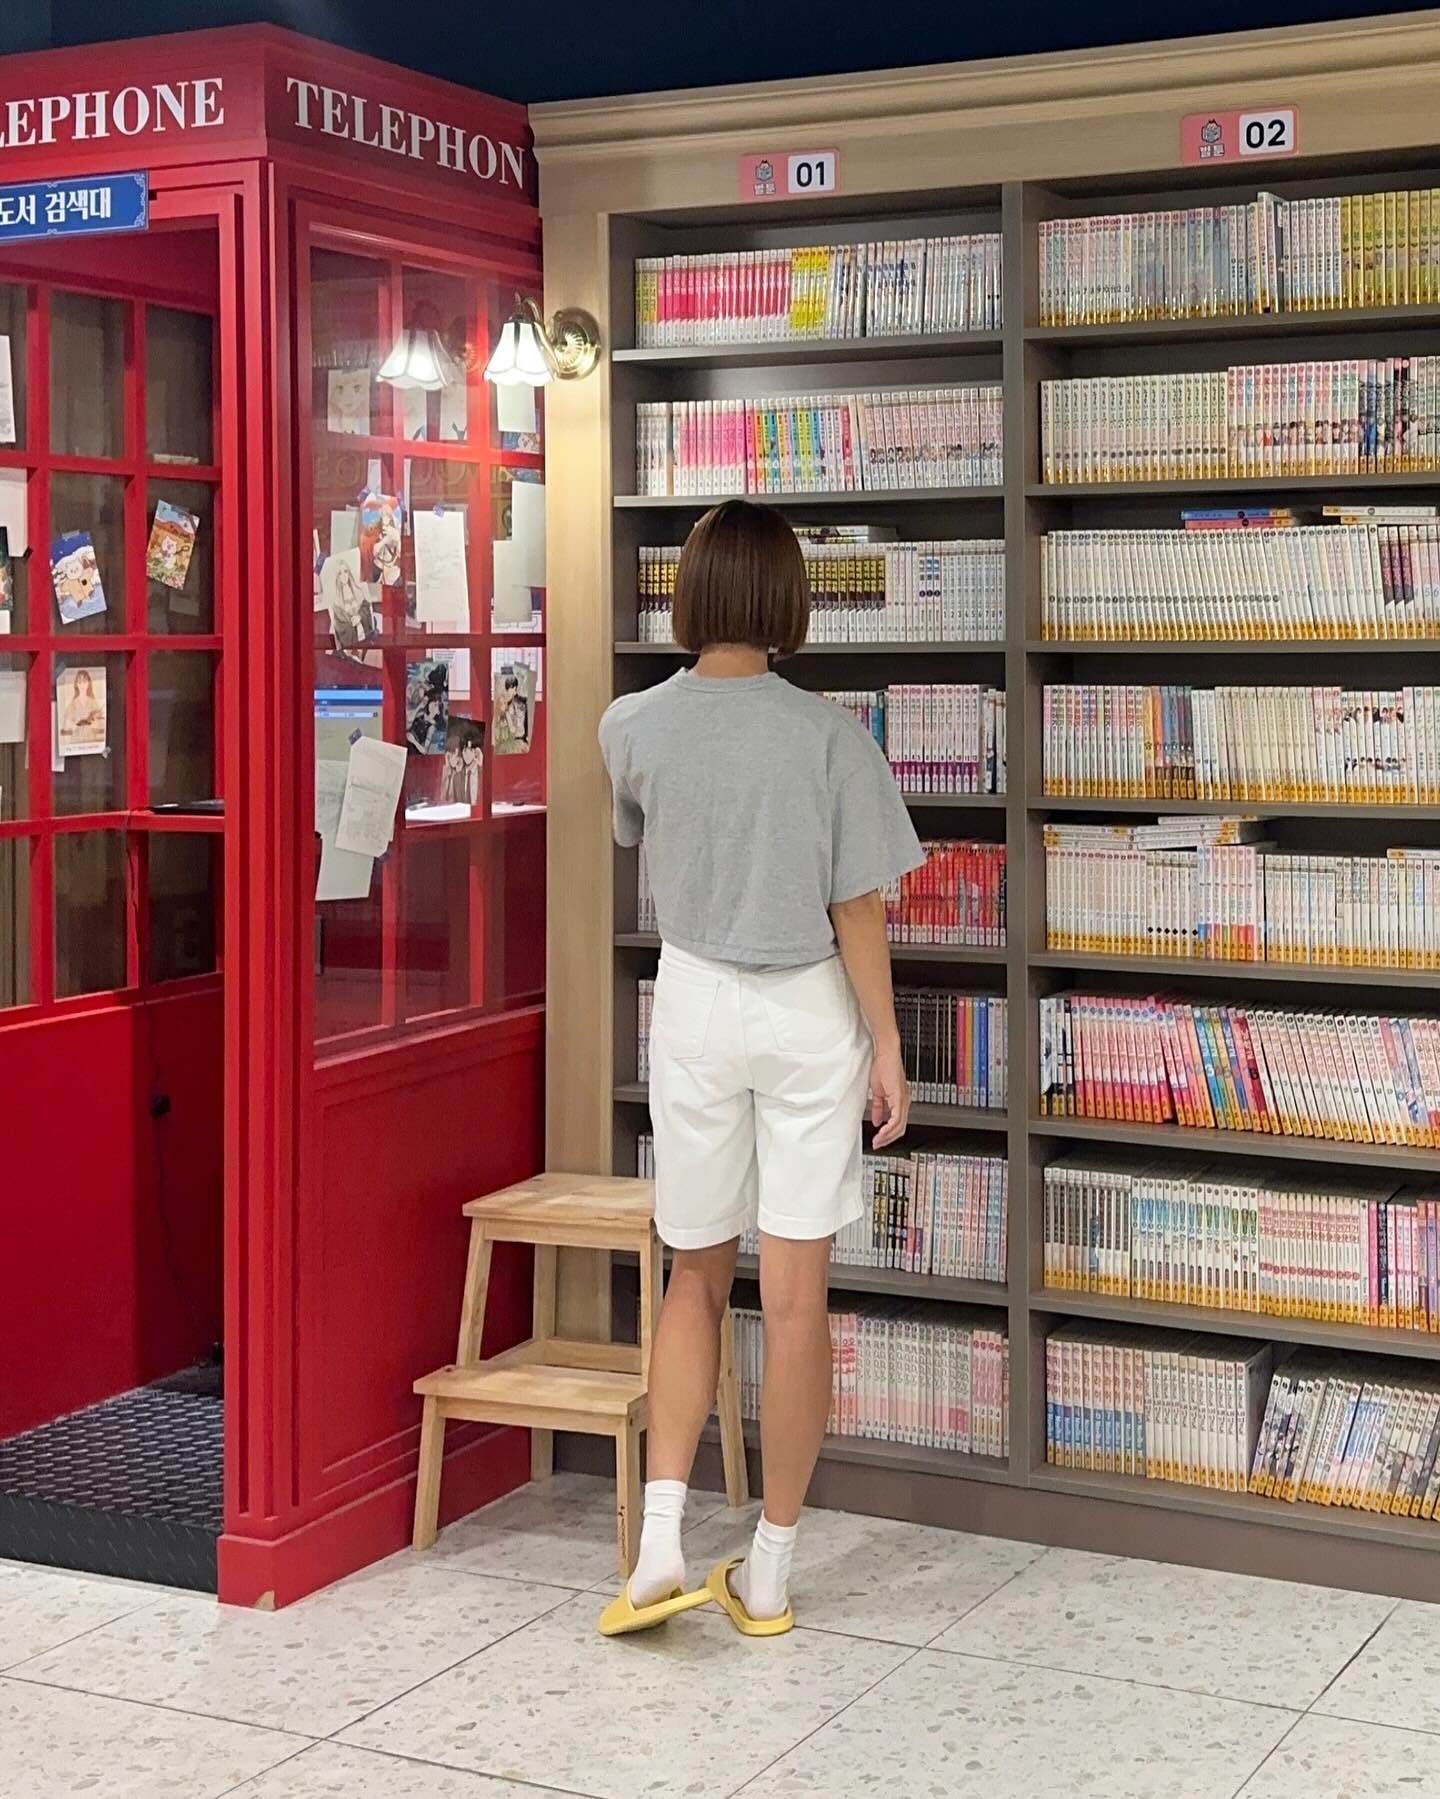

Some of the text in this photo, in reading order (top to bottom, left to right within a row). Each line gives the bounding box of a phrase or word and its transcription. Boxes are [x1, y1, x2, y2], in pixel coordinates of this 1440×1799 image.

[0, 77, 225, 148] EPHONE
[1245, 119, 1286, 149] 02
[796, 161, 825, 188] 01
[0, 187, 112, 226] 도서 검색대
